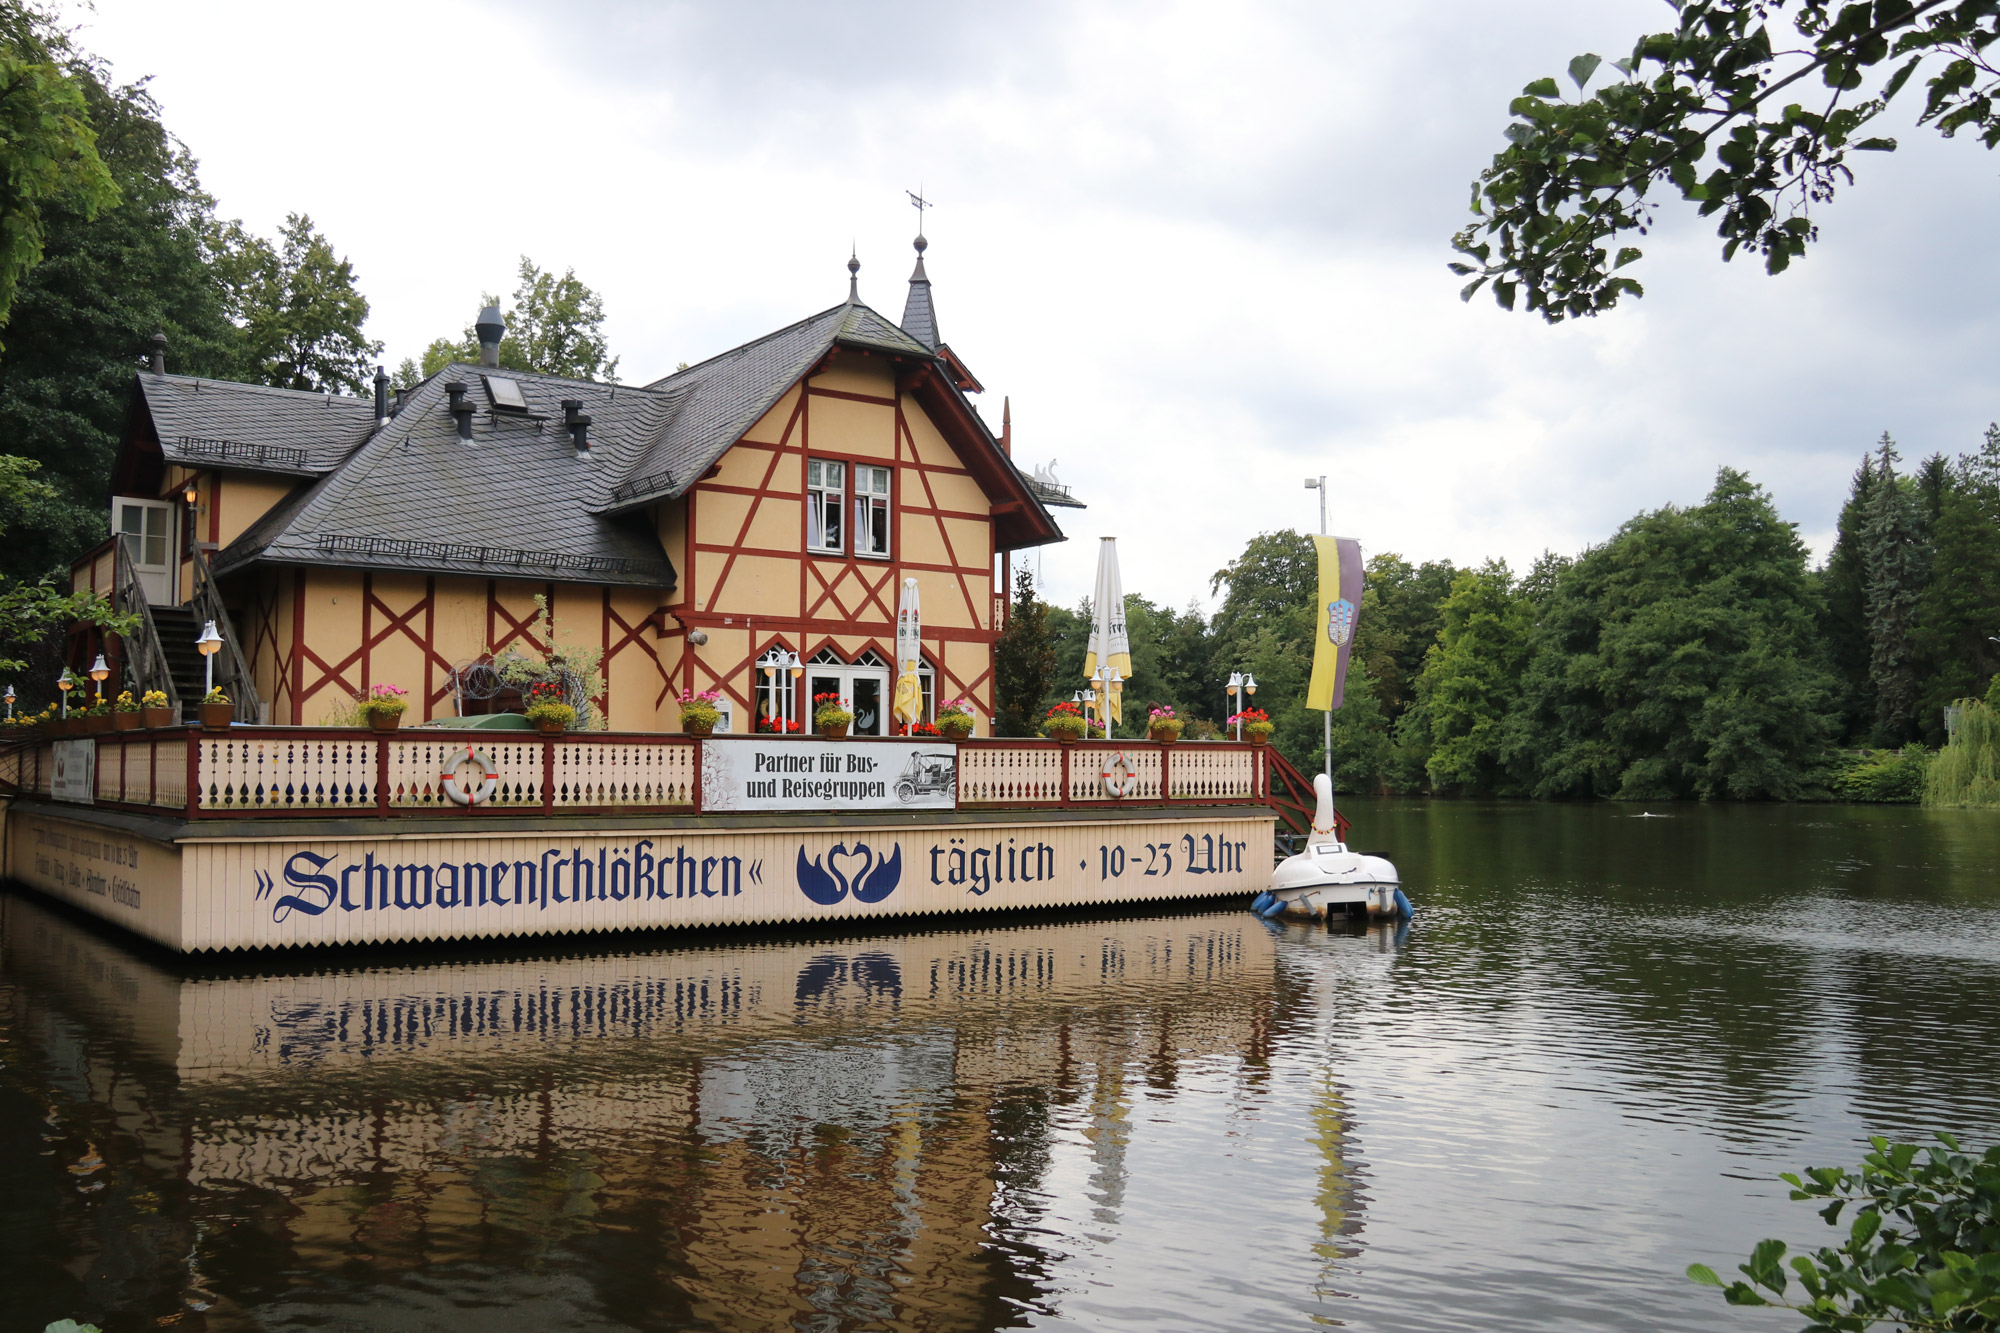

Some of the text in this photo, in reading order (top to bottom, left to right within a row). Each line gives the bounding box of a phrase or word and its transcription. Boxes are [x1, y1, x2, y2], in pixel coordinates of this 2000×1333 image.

[754, 752, 879, 773] Partner für Bus-
[746, 778, 886, 801] und Reisegruppen
[930, 838, 1055, 897] täglich
[1180, 832, 1246, 875] Uhr
